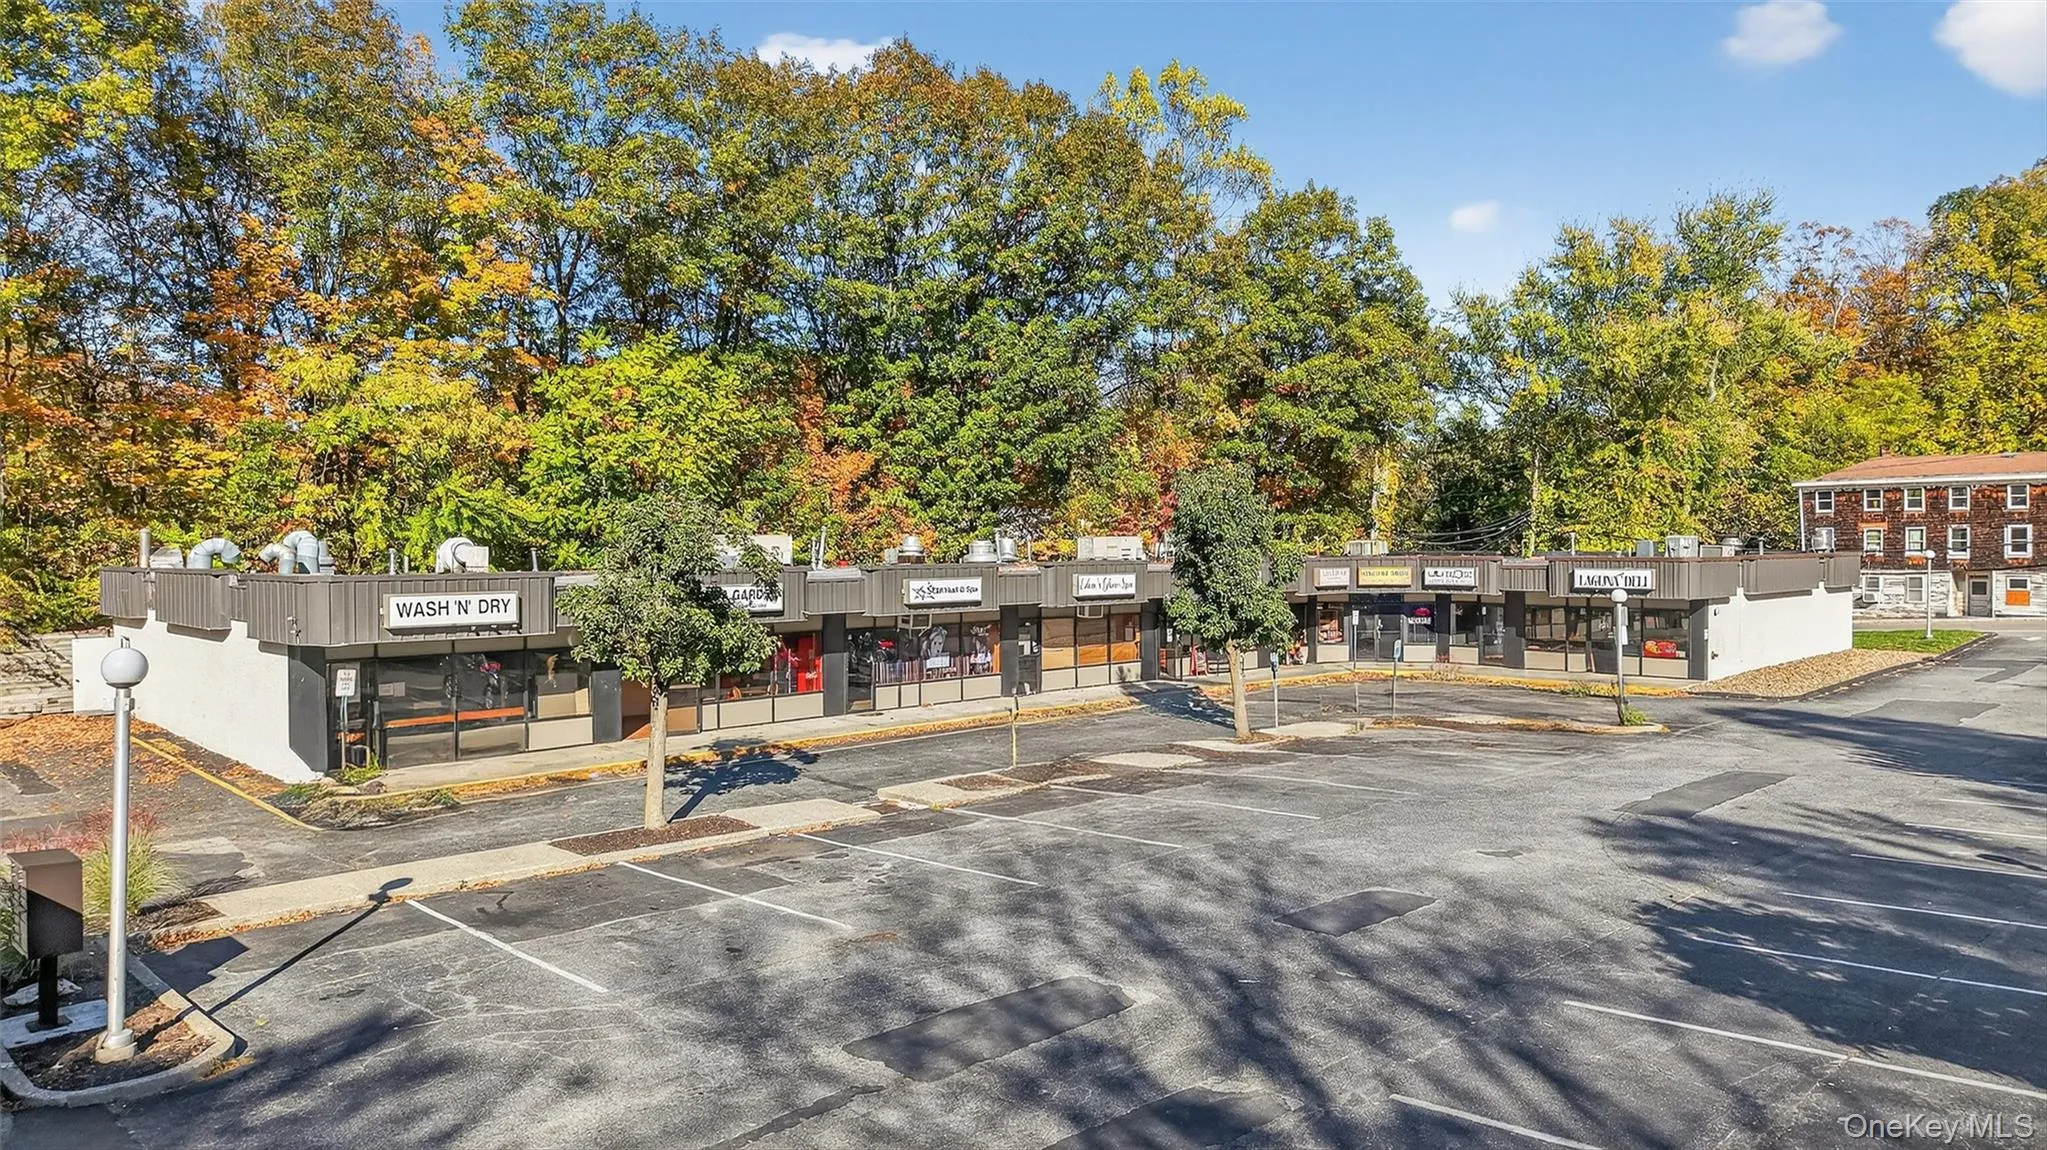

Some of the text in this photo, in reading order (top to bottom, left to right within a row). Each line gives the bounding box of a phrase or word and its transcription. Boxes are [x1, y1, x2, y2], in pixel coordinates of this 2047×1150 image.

[1624, 575, 1648, 587] DELI
[396, 599, 511, 618] WASH 'N' DRY
